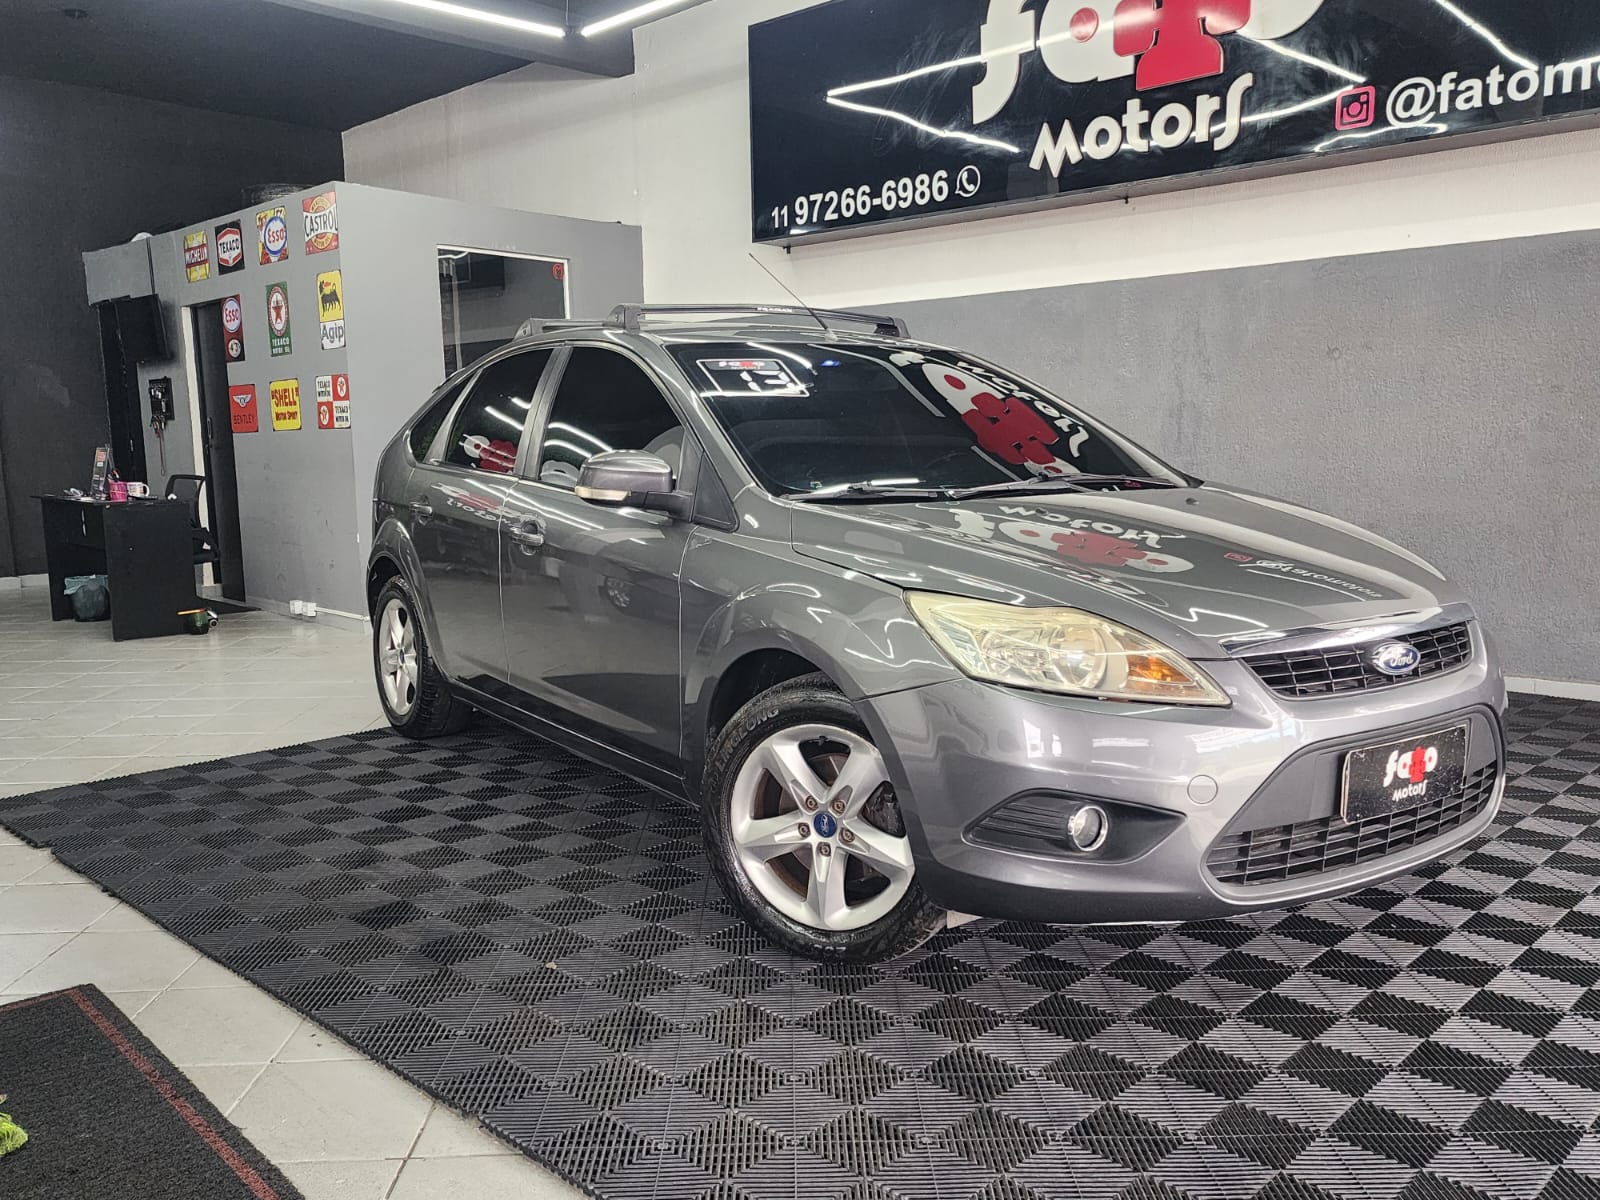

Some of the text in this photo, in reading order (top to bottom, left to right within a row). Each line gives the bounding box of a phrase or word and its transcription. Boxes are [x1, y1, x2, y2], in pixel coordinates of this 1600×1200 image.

[1386, 62, 1600, 128] @fatom
[1028, 72, 1254, 179] Motors
[771, 169, 949, 229] 11 97266-6986
[304, 206, 339, 238] CASTROL
[219, 238, 240, 254] TEXACO
[271, 337, 290, 347] TEXACO
[321, 322, 345, 343] Agip
[233, 414, 255, 425] BENTLEY
[1391, 779, 1429, 802] Motors
